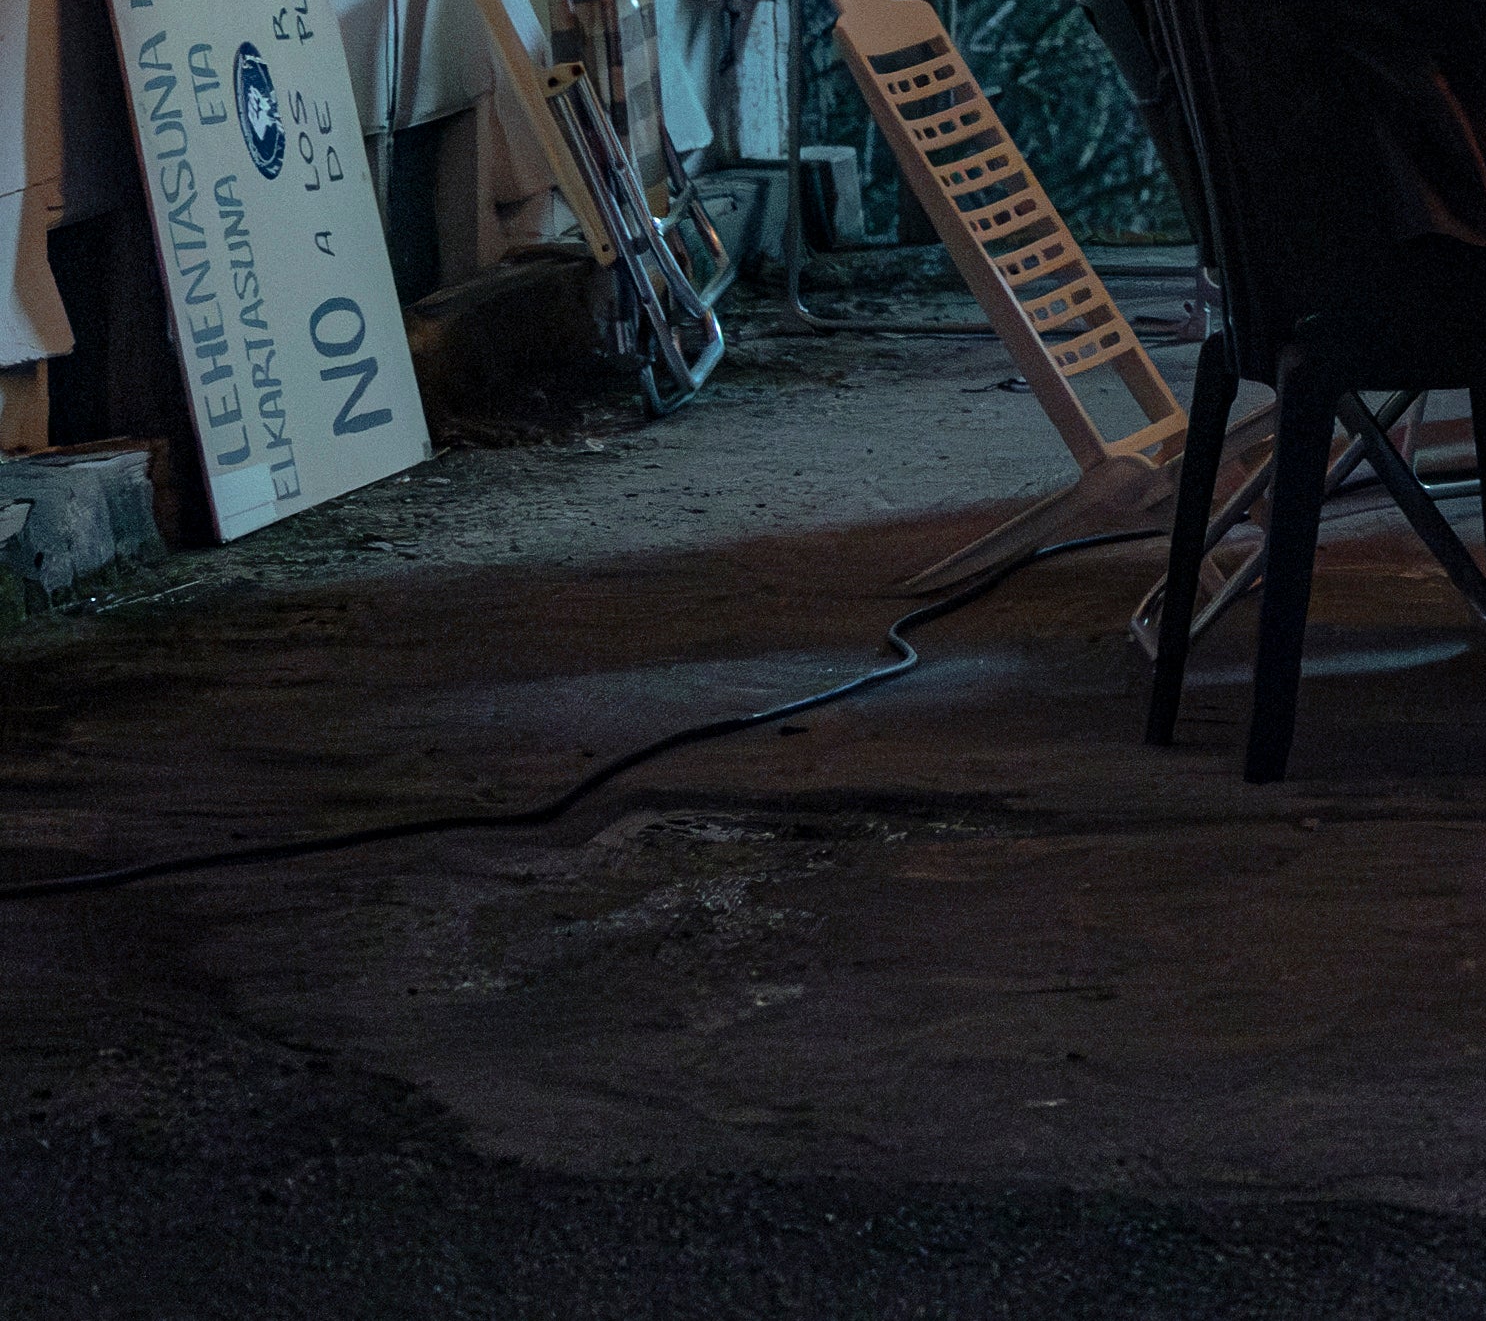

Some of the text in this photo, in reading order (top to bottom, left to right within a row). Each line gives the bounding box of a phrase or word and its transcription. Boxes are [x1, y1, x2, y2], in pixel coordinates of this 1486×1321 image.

[187, 41, 229, 126] ETA
[284, 89, 321, 191] LOS
[311, 100, 345, 182] DE
[139, 30, 249, 467] LEHENTASUNA
[314, 230, 335, 257] A
[213, 174, 301, 502] ELKARTASUNA
[309, 296, 393, 437] NO
